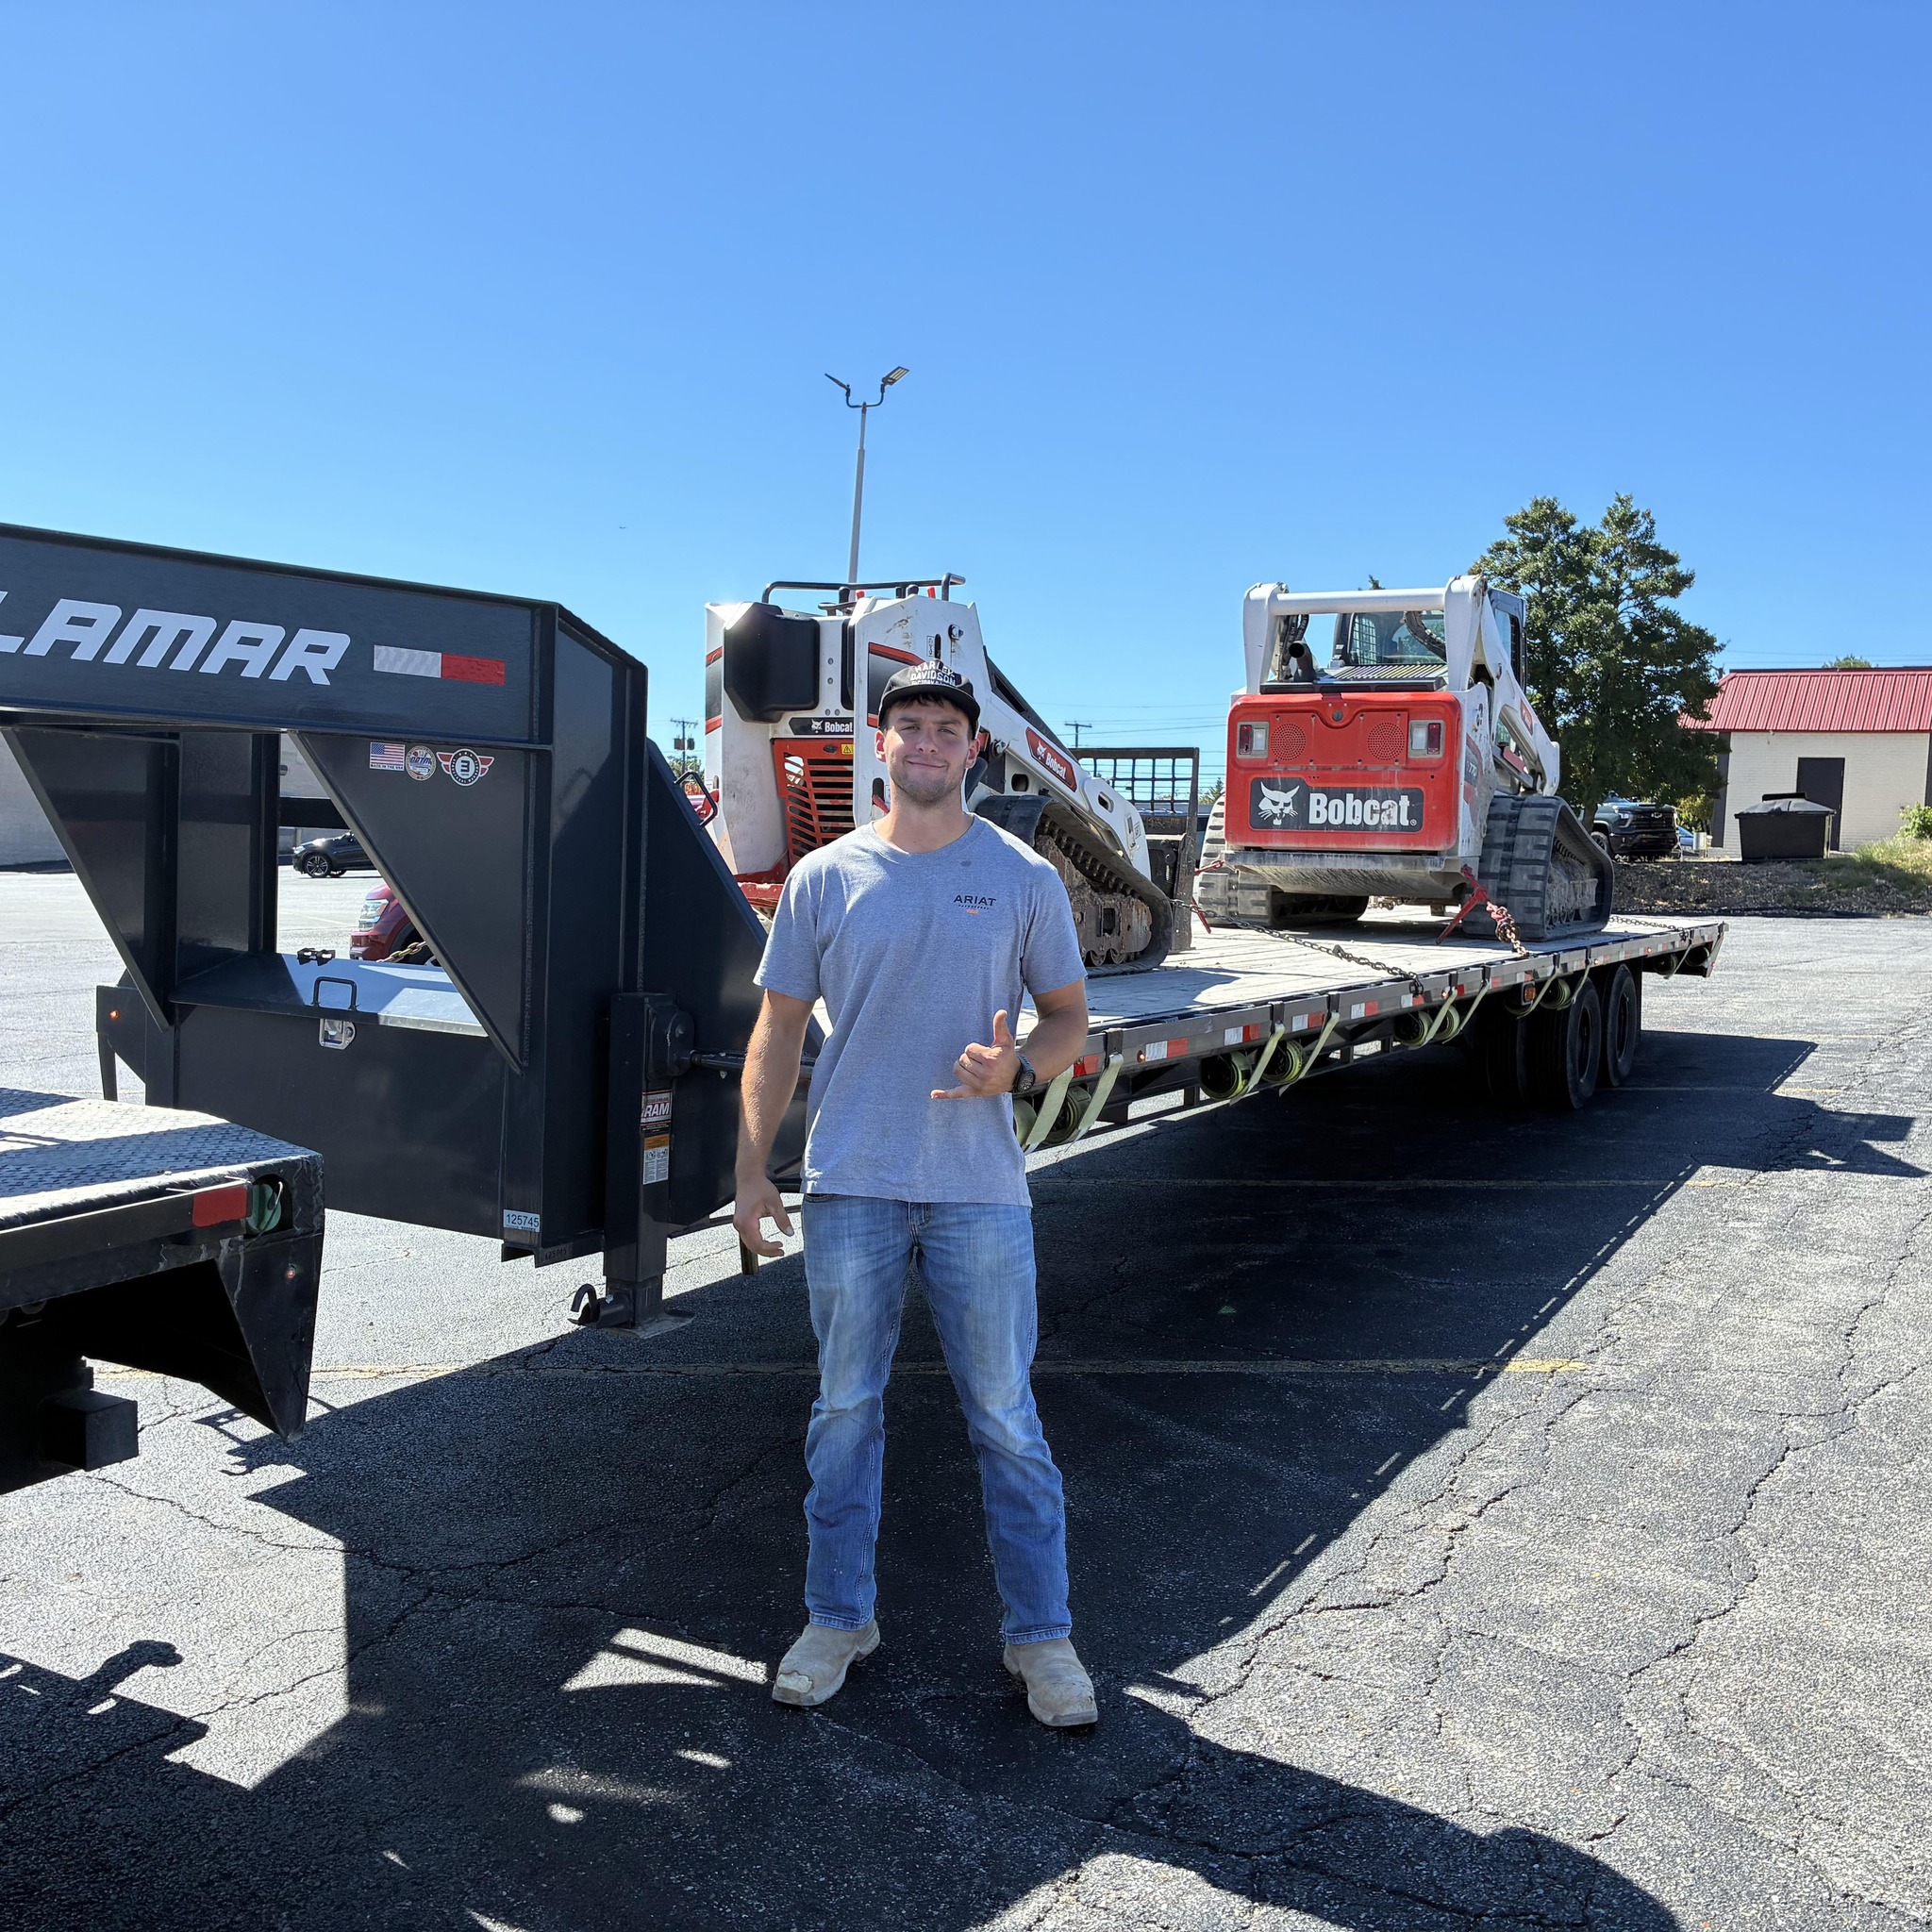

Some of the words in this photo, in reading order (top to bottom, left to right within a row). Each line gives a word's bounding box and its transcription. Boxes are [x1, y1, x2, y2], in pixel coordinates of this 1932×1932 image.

[910, 670, 956, 686] DAVIDSON
[824, 722, 853, 733] Bobcat
[460, 759, 470, 773] 3
[1045, 752, 1066, 779] Bobcat
[1308, 792, 1410, 826] Bobcat
[954, 894, 996, 906] ARIAT
[643, 1102, 670, 1117] RAM
[506, 1213, 540, 1227] 125745
